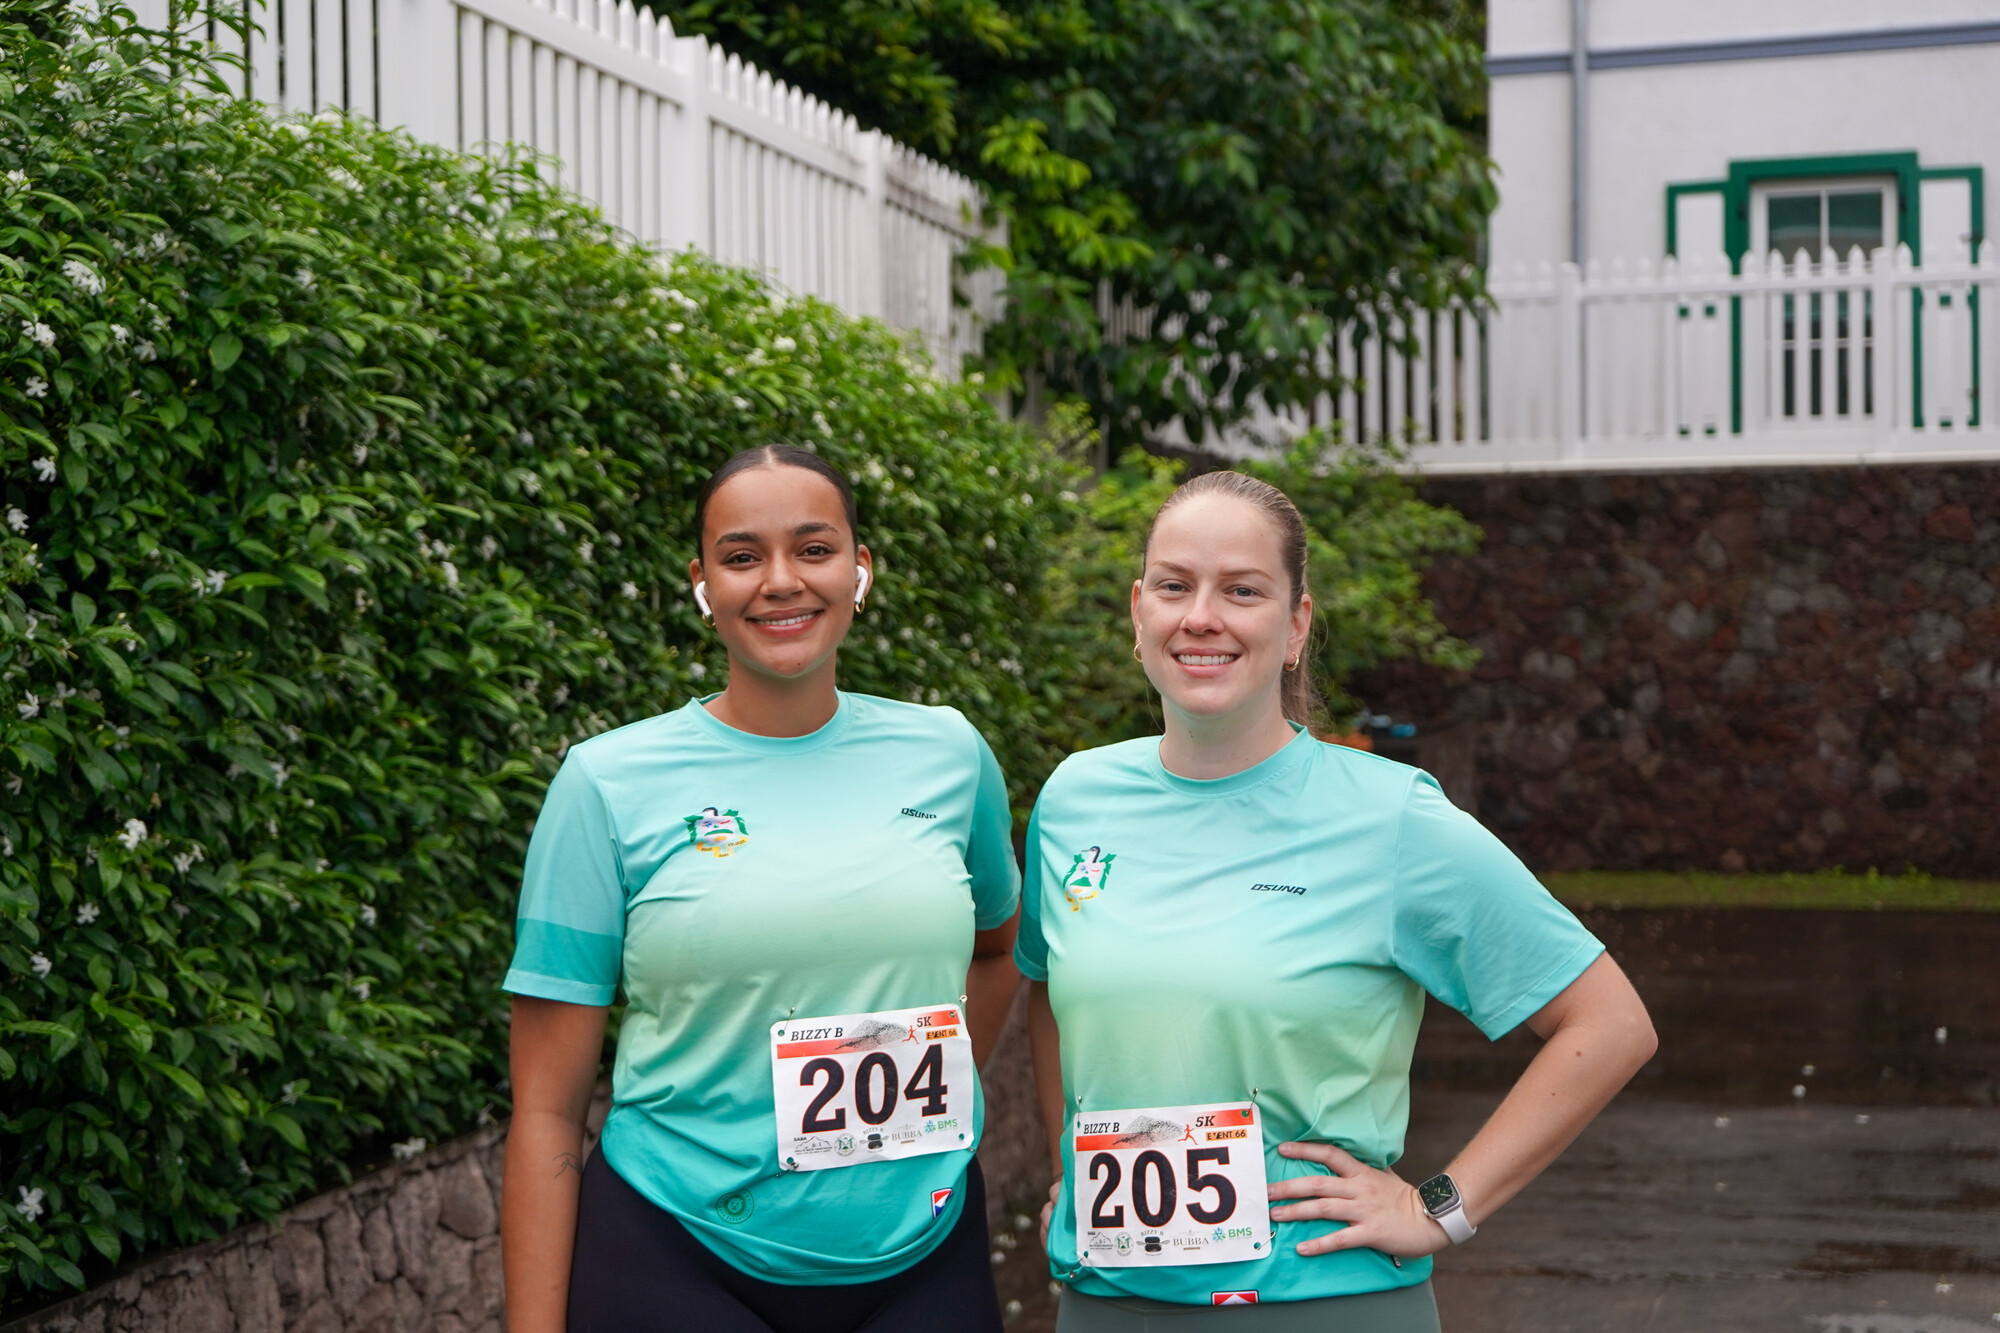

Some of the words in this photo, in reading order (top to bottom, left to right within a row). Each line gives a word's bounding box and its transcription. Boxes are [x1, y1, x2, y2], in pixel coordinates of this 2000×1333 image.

[1250, 883, 1307, 896] OSUNA
[917, 1016, 932, 1027] 5K
[791, 1028, 832, 1041] BIZZY
[835, 1027, 843, 1038] B
[800, 1043, 948, 1134] 204
[937, 1119, 958, 1129] BMS
[1195, 1115, 1215, 1127] 5K
[1084, 1122, 1111, 1134] BIZZY
[1112, 1122, 1120, 1132] B
[892, 1130, 922, 1141] BUBBA
[1089, 1147, 1237, 1228] 205
[1228, 1227, 1253, 1238] BMS
[1173, 1237, 1209, 1246] BUBBA
